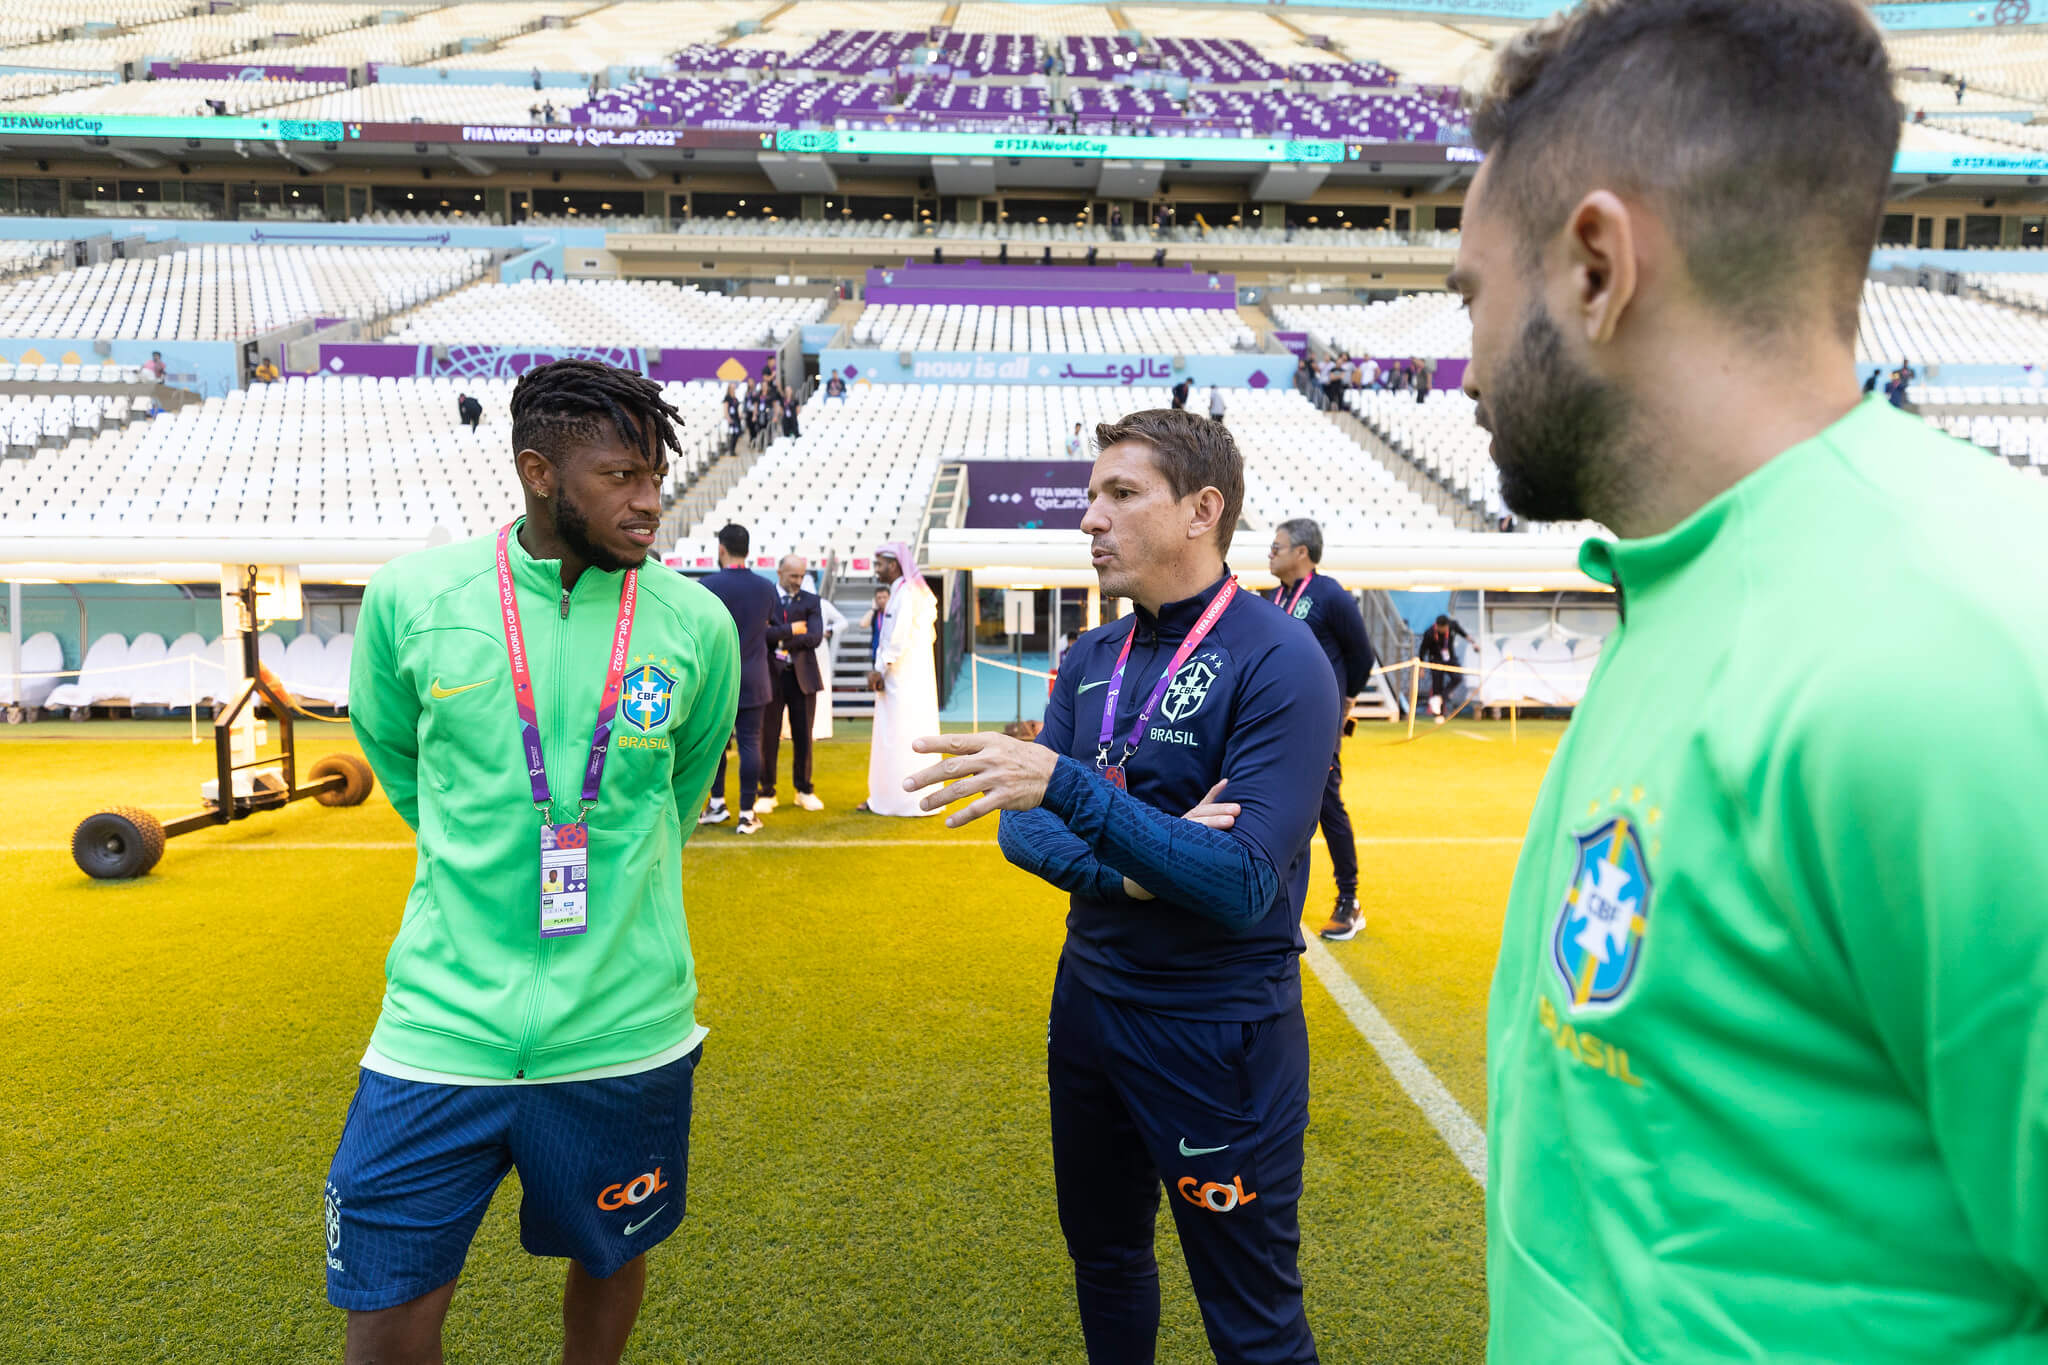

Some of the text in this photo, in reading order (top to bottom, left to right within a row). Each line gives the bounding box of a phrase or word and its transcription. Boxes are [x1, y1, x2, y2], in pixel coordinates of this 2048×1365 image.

[462, 126, 494, 141] FIFA
[494, 127, 545, 143] WORLD
[545, 128, 574, 143] CUP
[994, 138, 1108, 157] #FIFAWorldCup
[914, 356, 1031, 378] now is all
[1031, 487, 1054, 498] FIFA
[506, 608, 515, 624] CUP
[623, 600, 632, 616] CUP
[1195, 619, 1210, 635] FIFA
[1206, 595, 1227, 620] WORLD
[508, 625, 521, 655] WORLD
[514, 655, 524, 673] FIFA
[637, 692, 657, 701] CBF
[1179, 687, 1197, 695] CBF
[618, 736, 669, 750] BRASIL
[1150, 727, 1199, 746] BRASIL
[597, 1166, 668, 1211] GOL
[1177, 1175, 1257, 1212] GOL
